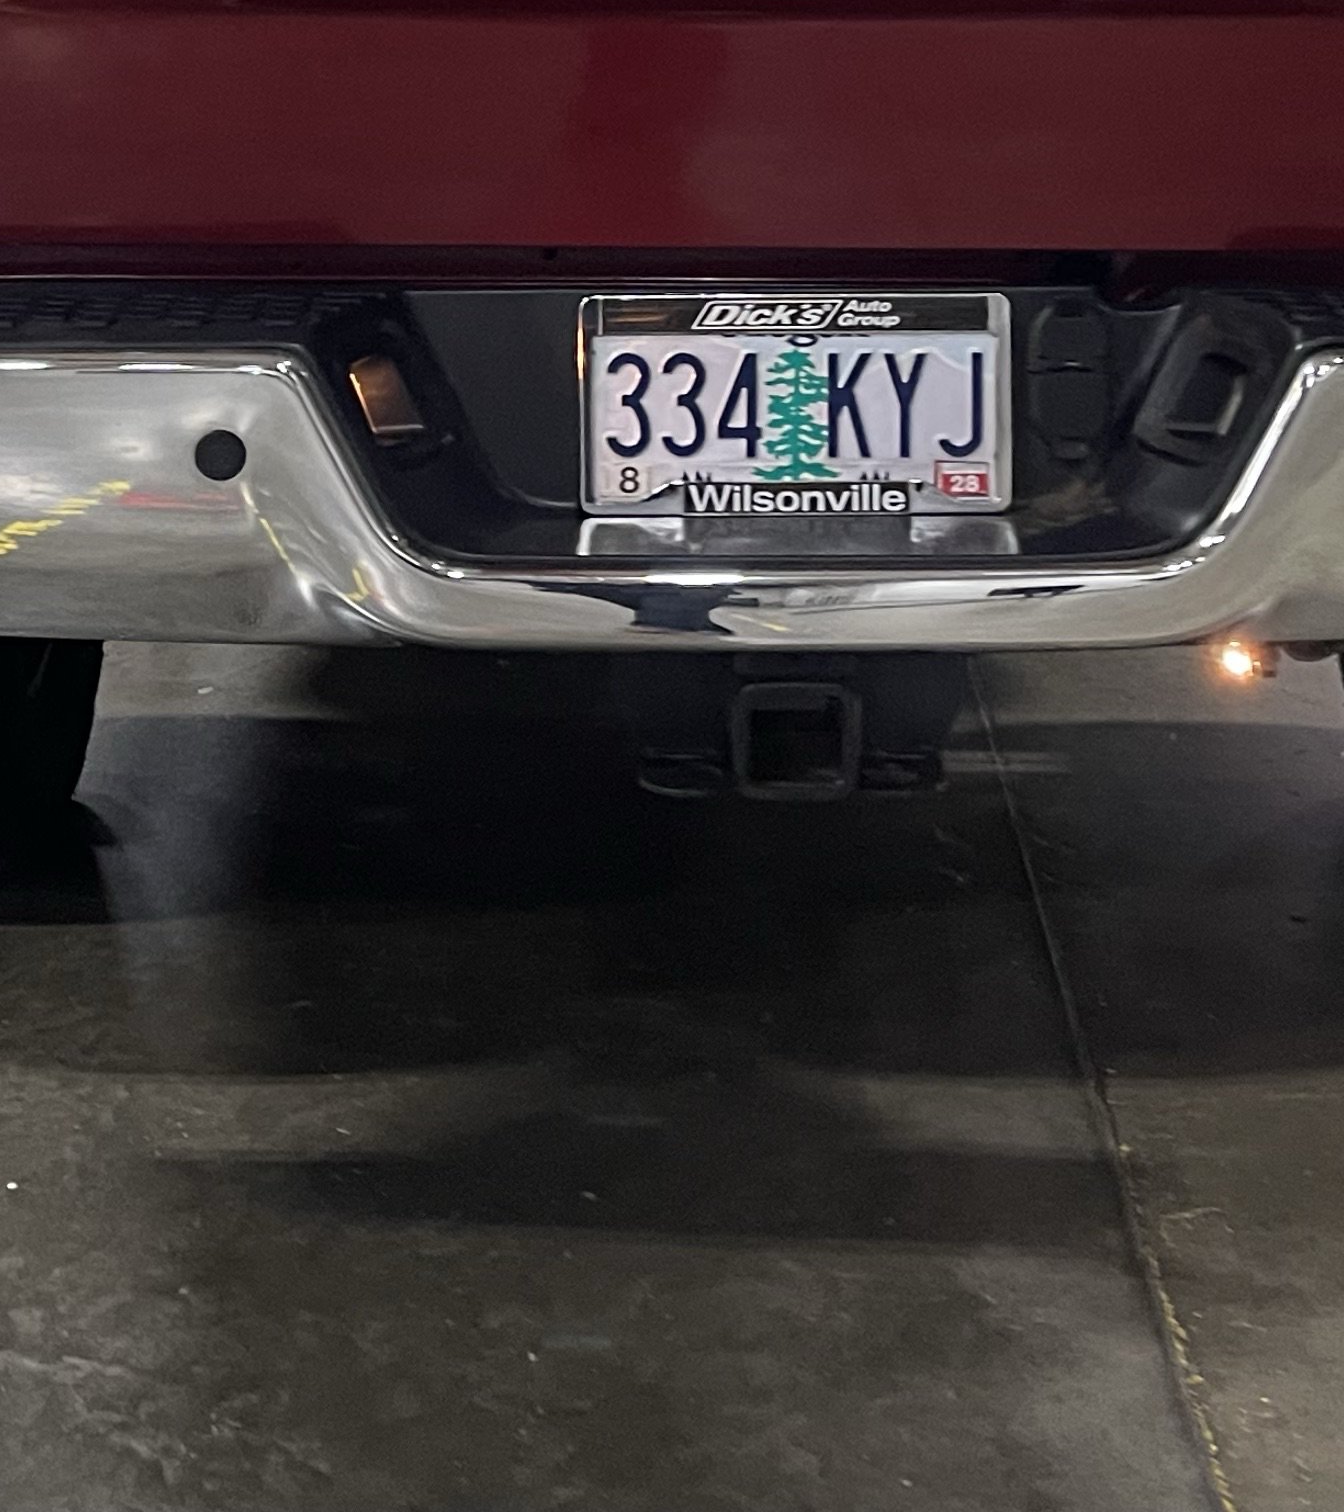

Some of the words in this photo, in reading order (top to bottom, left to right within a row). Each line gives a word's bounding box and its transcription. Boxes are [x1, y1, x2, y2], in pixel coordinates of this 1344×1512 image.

[702, 304, 826, 326] Dick's
[843, 300, 892, 312] Auto
[837, 314, 901, 328] Group
[606, 352, 762, 458] 334
[828, 352, 984, 458] KYJ
[619, 467, 639, 493] 8
[950, 475, 980, 492] 28
[690, 485, 907, 513] Wilsonville
